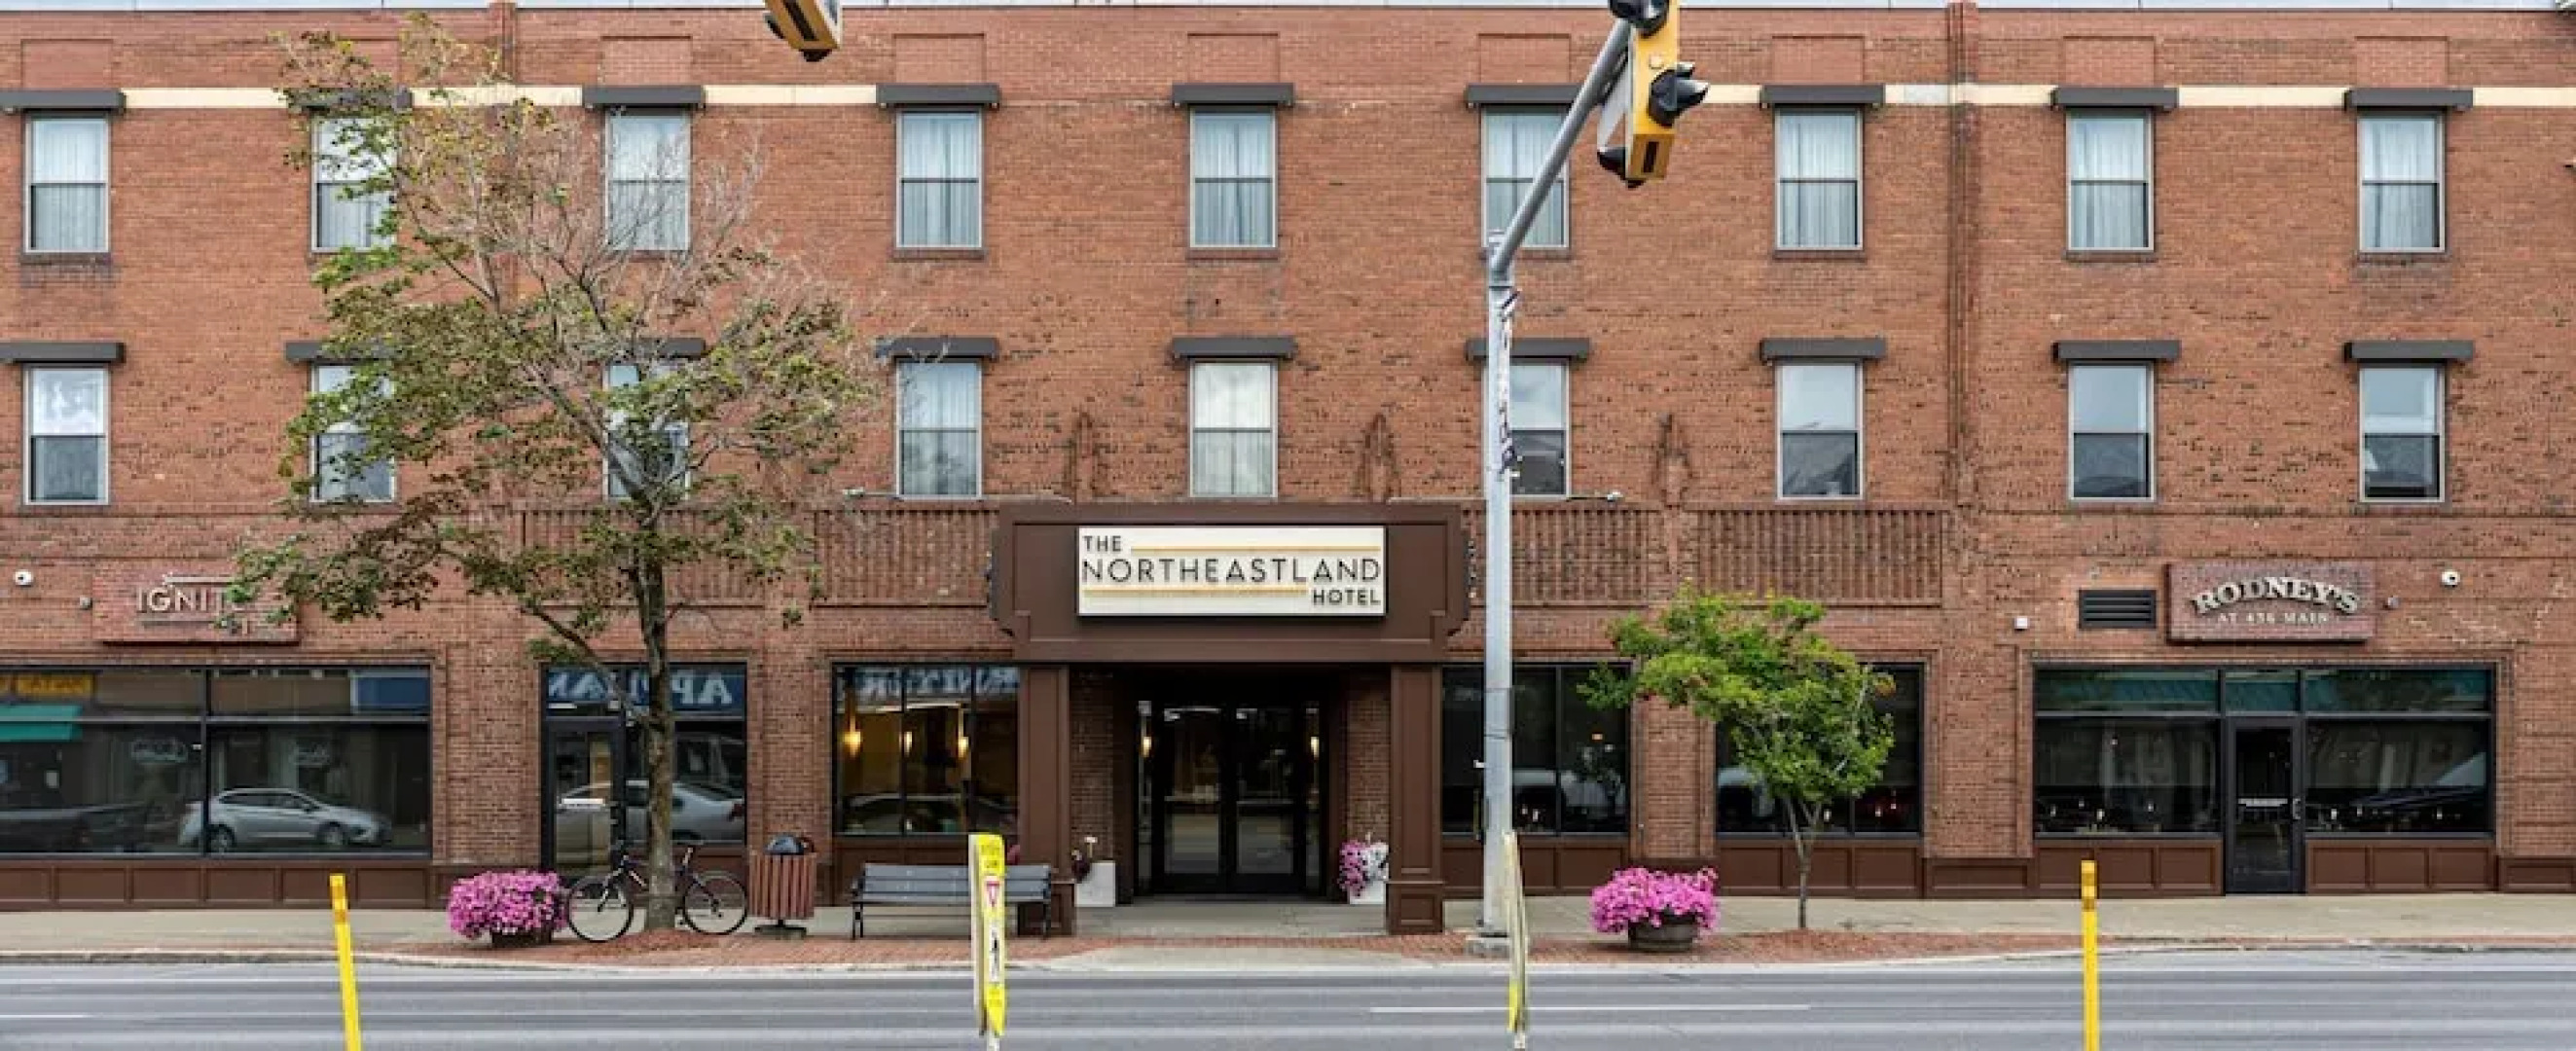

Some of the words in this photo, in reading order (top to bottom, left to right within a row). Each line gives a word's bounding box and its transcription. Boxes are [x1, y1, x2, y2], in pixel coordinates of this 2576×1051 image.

[1083, 535, 1122, 552] THE
[1081, 558, 1382, 583] NORTHEASTLAND
[1312, 588, 1382, 606] HOTEL
[2195, 576, 2361, 614] RODNEY'S
[2219, 612, 2237, 624] AT
[2284, 612, 2330, 624] MAIN
